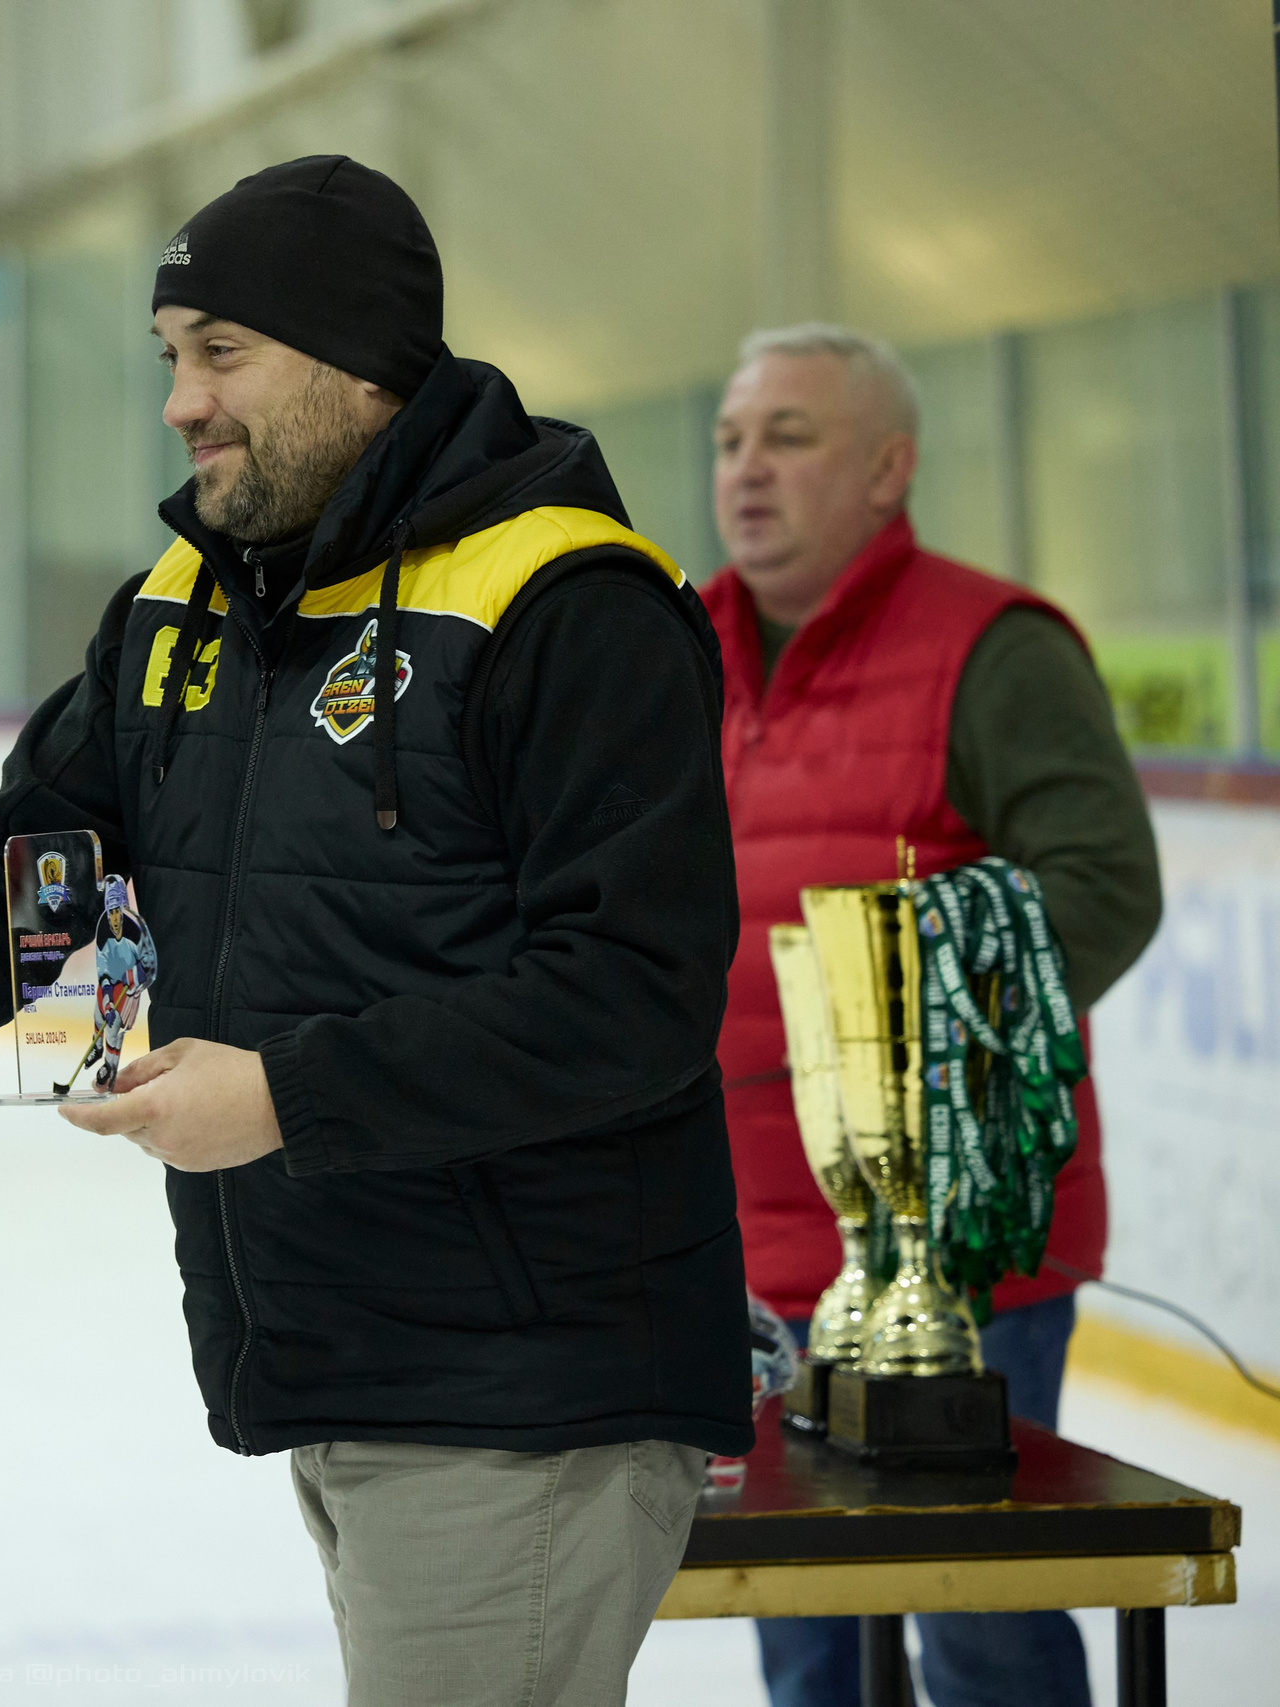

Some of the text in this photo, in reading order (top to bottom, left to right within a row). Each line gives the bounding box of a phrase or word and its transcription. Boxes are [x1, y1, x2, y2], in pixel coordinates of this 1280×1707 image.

[321, 678, 365, 698] GREN
[323, 698, 376, 716] DIZE
[22, 981, 96, 1002] Паршин Станислав
[25, 1030, 67, 1045] SHLIGA 2024/25
